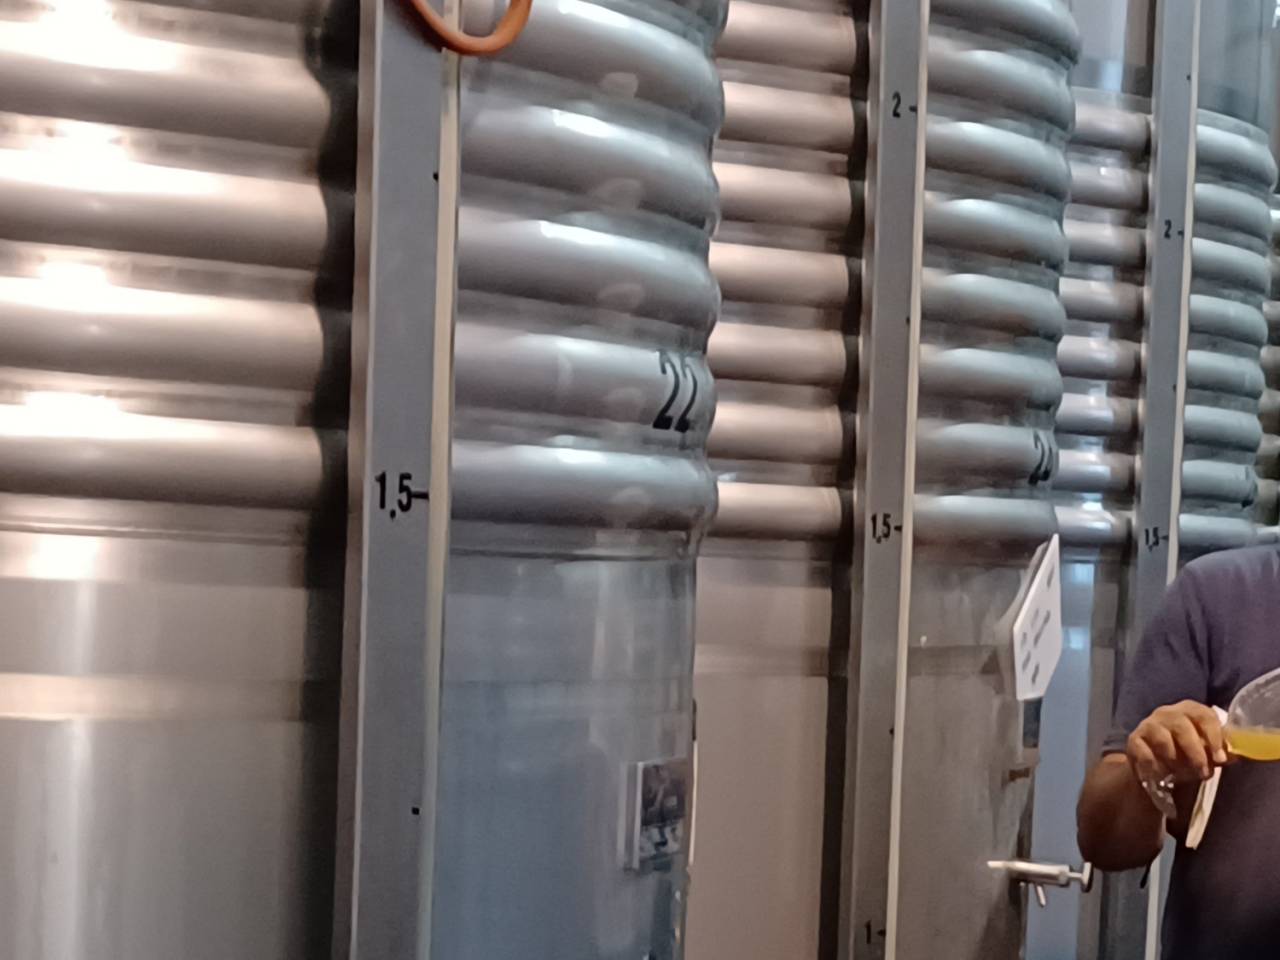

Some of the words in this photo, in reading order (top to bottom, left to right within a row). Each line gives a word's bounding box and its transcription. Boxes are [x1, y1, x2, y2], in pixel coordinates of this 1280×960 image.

[892, 91, 901, 118] 2
[1164, 219, 1172, 239] 2
[653, 349, 698, 432] 22
[865, 919, 872, 945] 1
